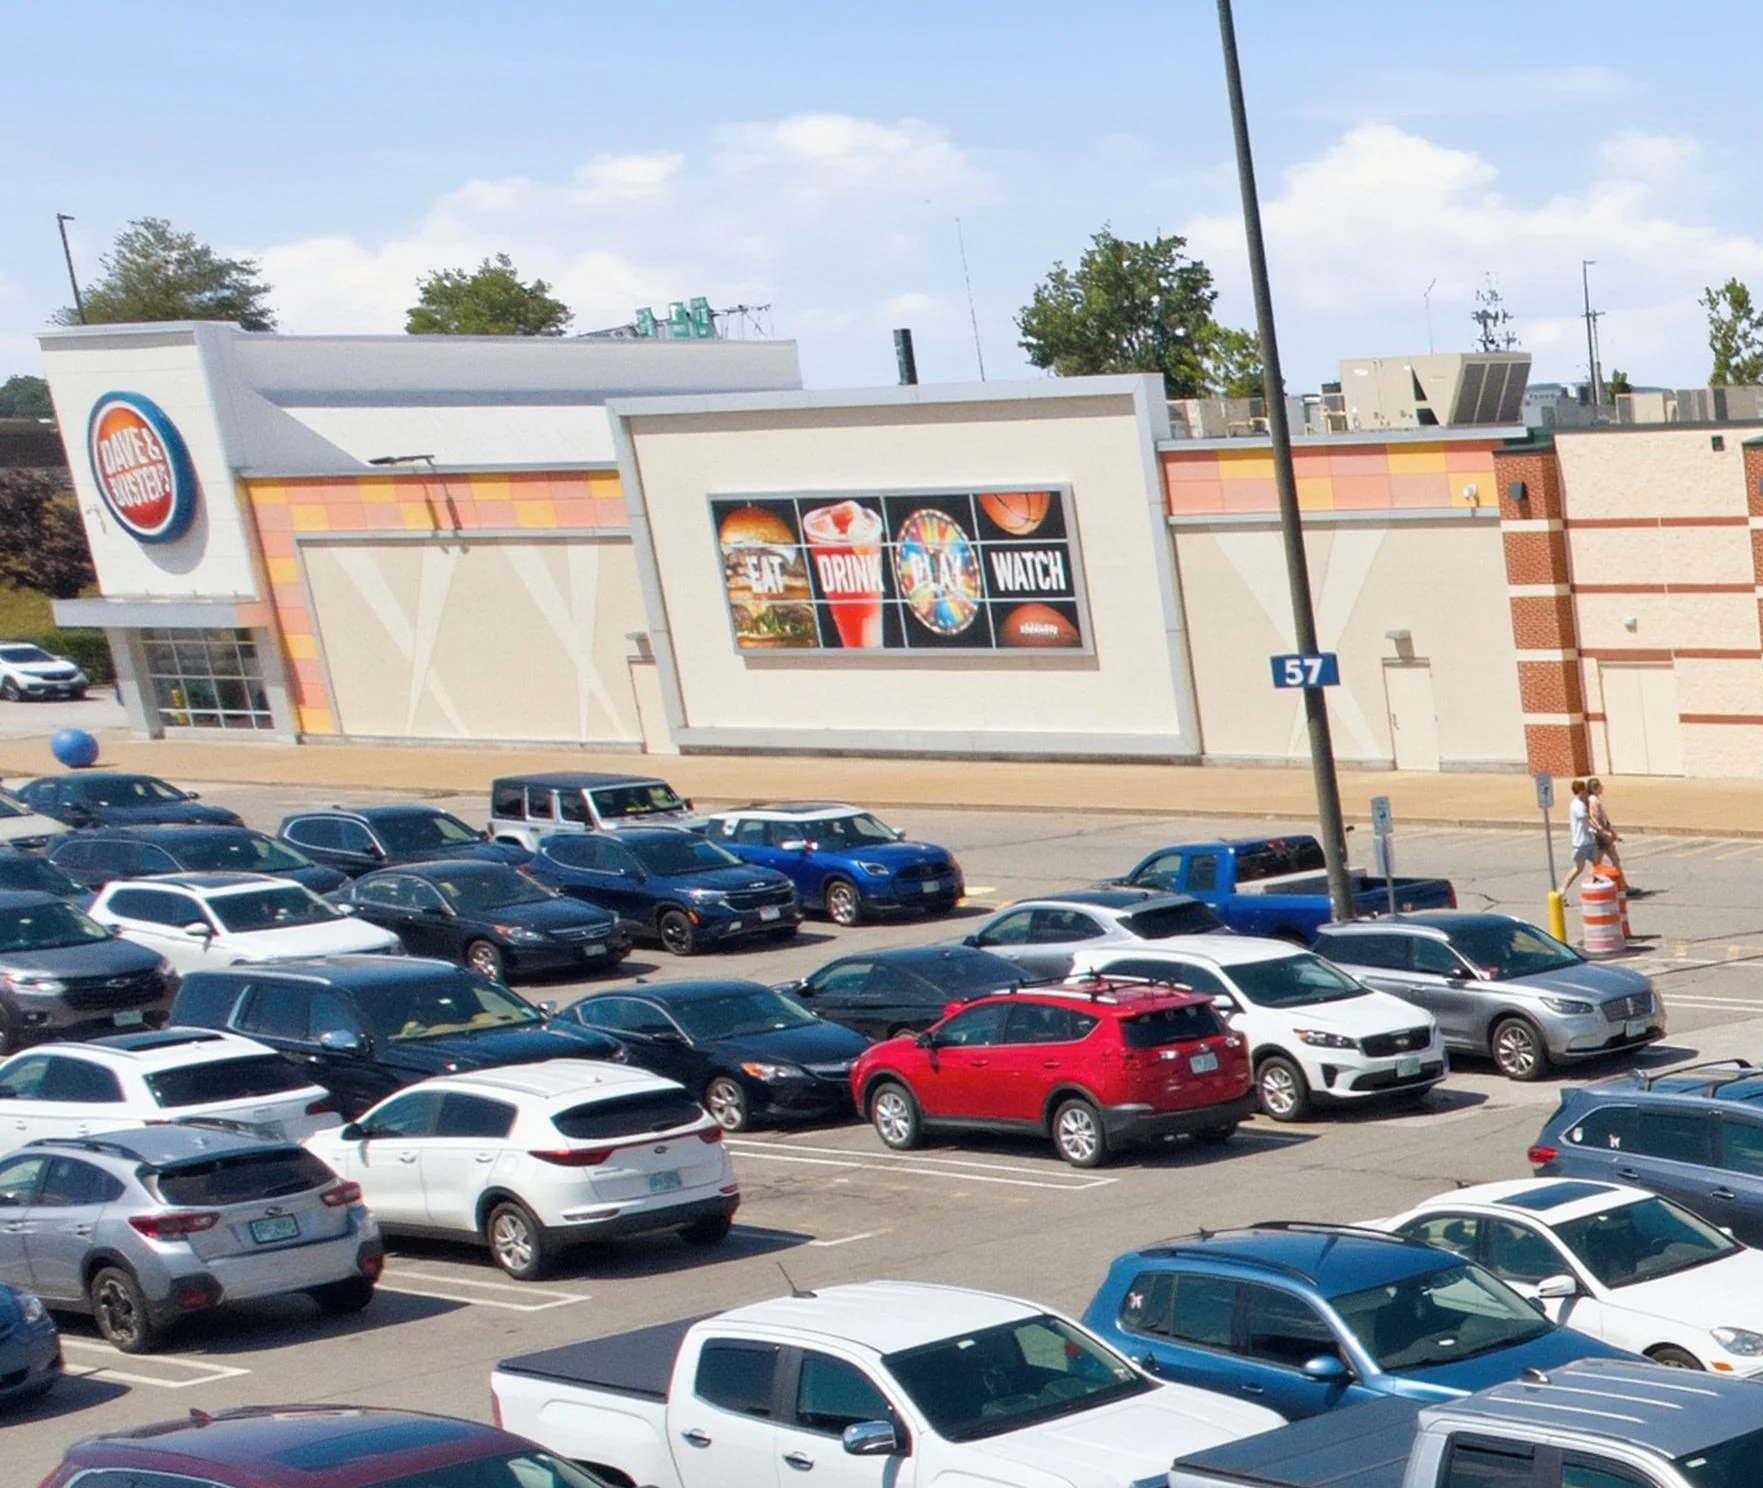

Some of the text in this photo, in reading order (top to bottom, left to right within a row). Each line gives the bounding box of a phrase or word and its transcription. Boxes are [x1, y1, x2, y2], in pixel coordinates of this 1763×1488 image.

[749, 555, 785, 594] EAT
[818, 554, 886, 593] DRINK
[911, 553, 963, 592] PLAY
[990, 550, 1067, 593] WATCH
[1284, 657, 1324, 686] 57
